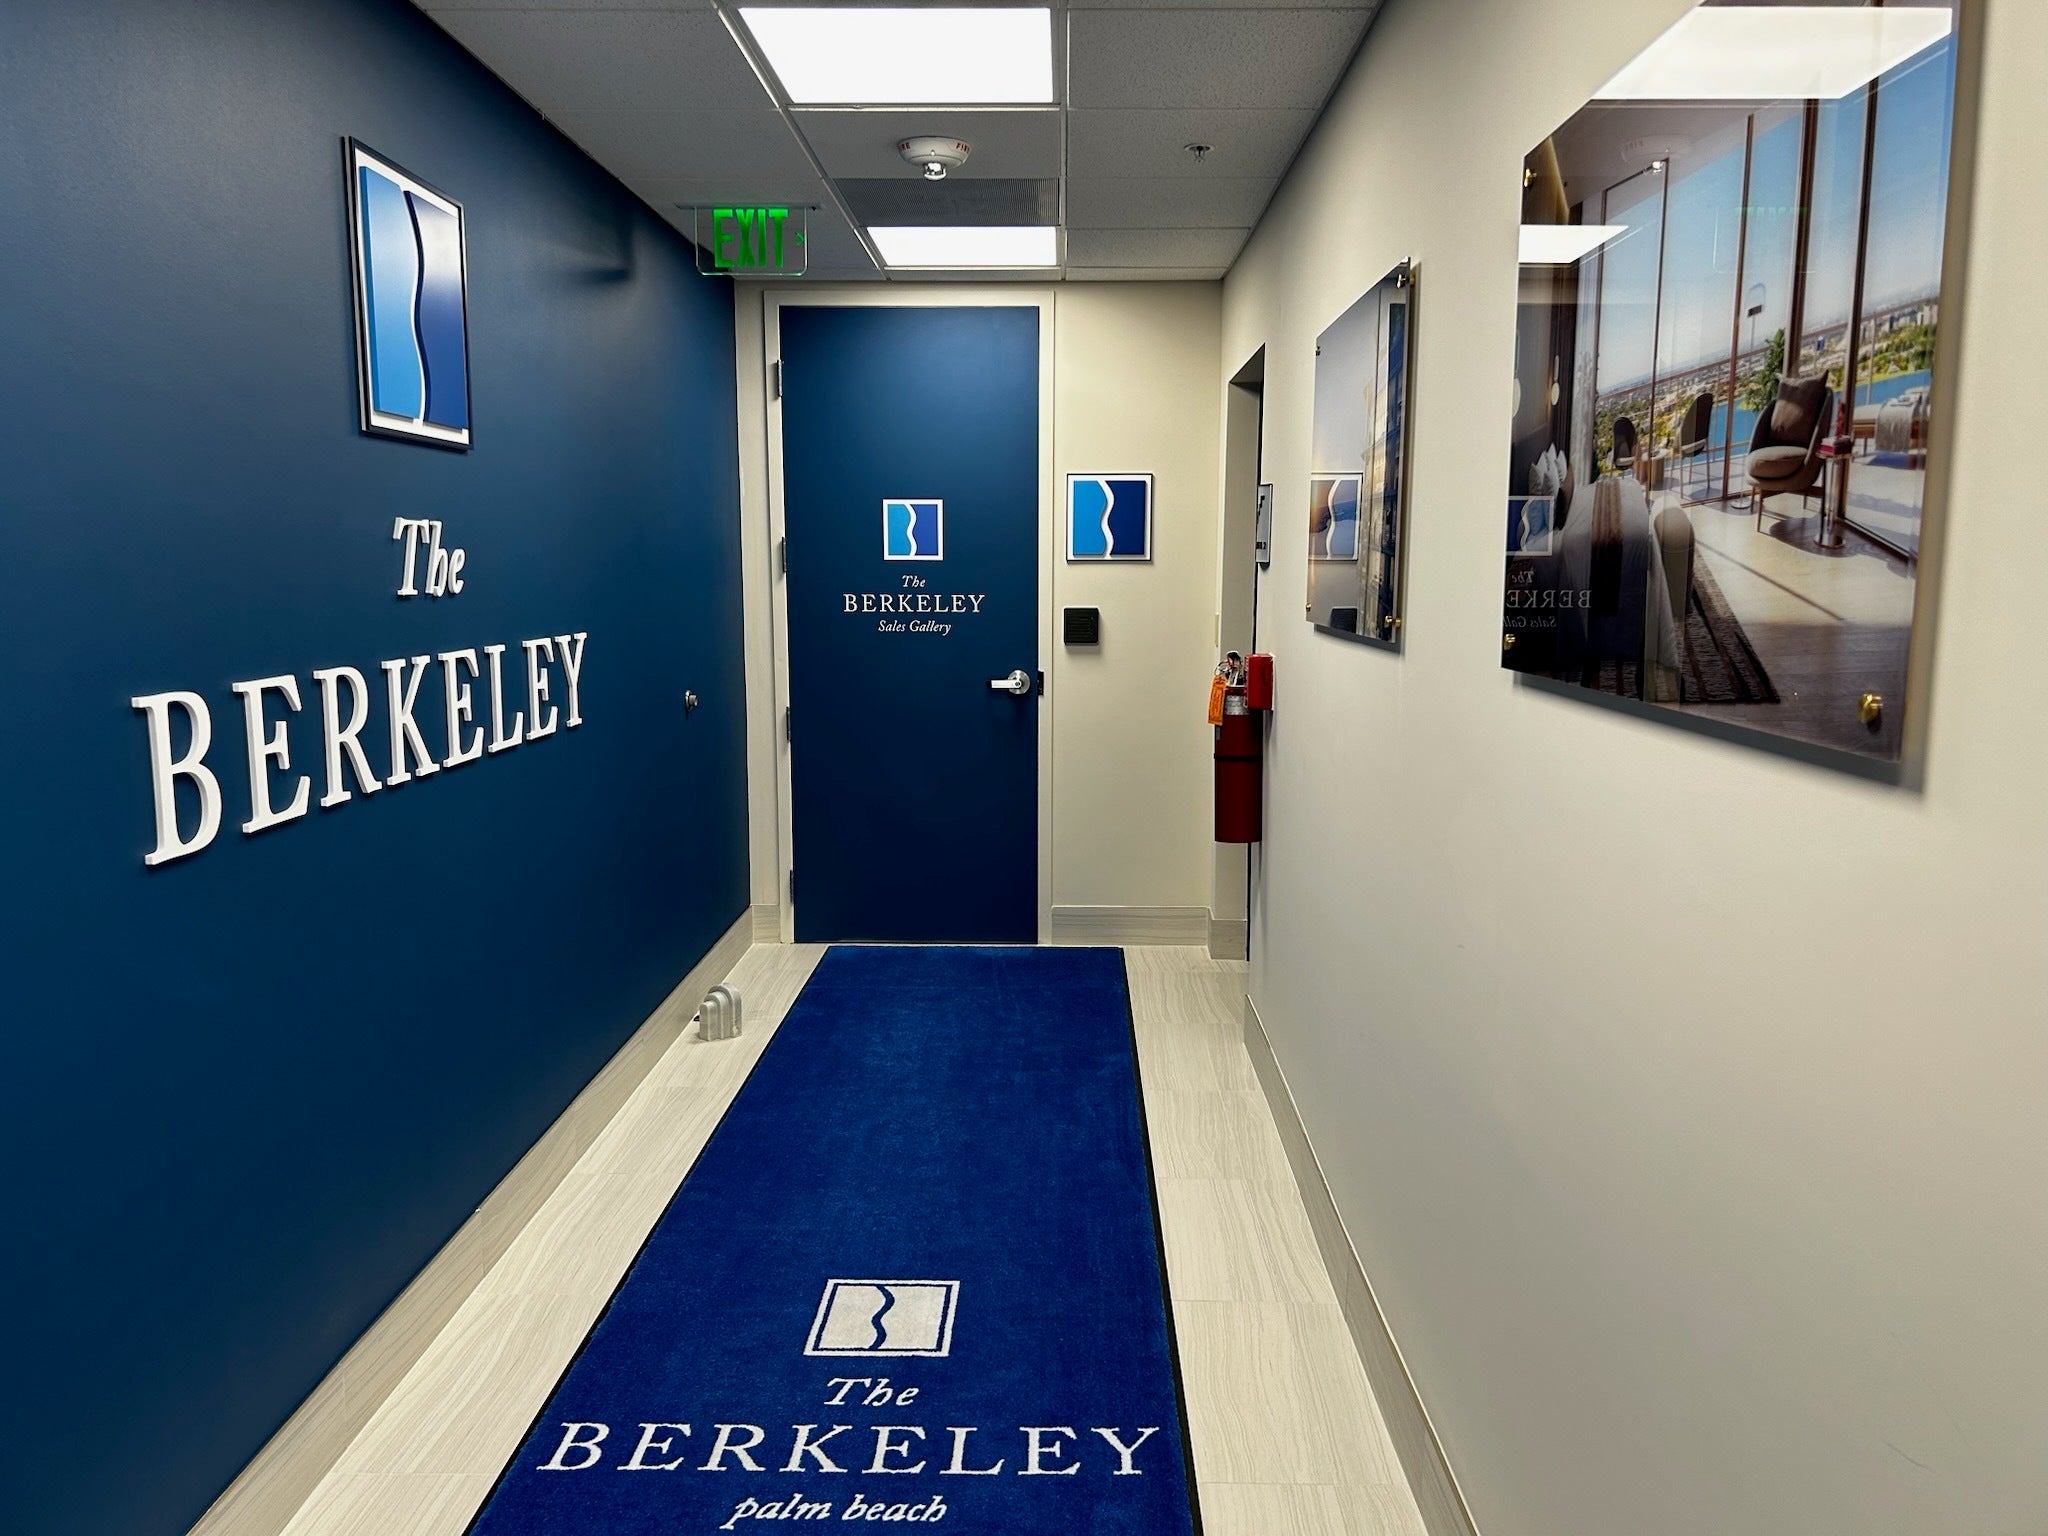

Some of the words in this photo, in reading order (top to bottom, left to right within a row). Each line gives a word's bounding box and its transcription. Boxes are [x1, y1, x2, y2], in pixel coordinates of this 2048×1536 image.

[713, 208, 789, 268] EXIT
[393, 517, 466, 597] The
[902, 575, 926, 588] The
[843, 593, 985, 613] BERKELEY
[878, 619, 906, 632] Sales
[909, 619, 952, 636] Gallery
[131, 632, 588, 866] BERKELEY
[824, 1377, 919, 1407] The
[536, 1422, 1160, 1476] BERKELEY
[718, 1492, 833, 1530] palm
[841, 1493, 948, 1523] beach
